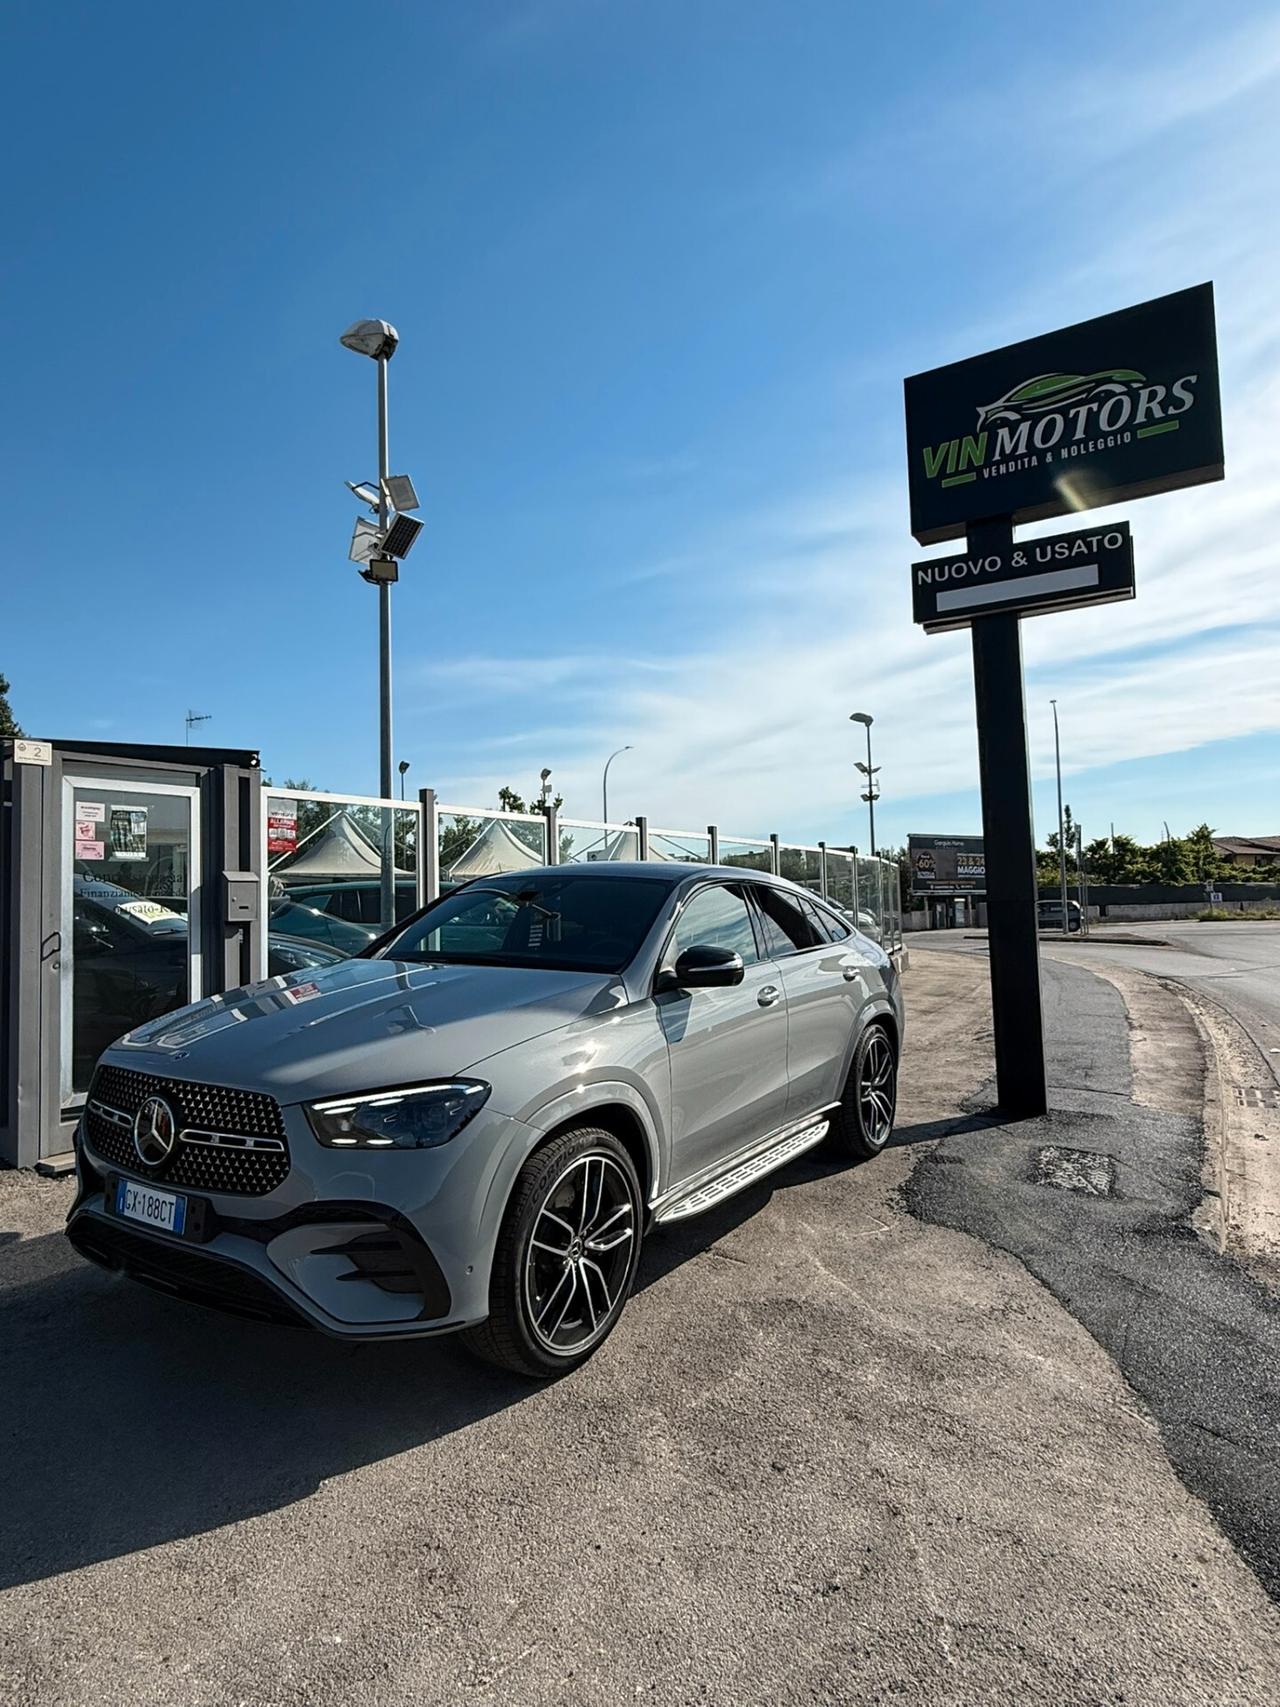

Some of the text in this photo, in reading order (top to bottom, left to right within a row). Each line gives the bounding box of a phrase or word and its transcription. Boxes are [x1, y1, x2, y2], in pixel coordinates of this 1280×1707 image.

[922, 374, 1198, 479] VIN MOTORS
[982, 431, 1131, 480] VENDITA & NOLEGGIO
[917, 532, 1123, 585] NUOVO & USATO
[34, 747, 42, 757] 2
[957, 866, 986, 874] MAGGIO
